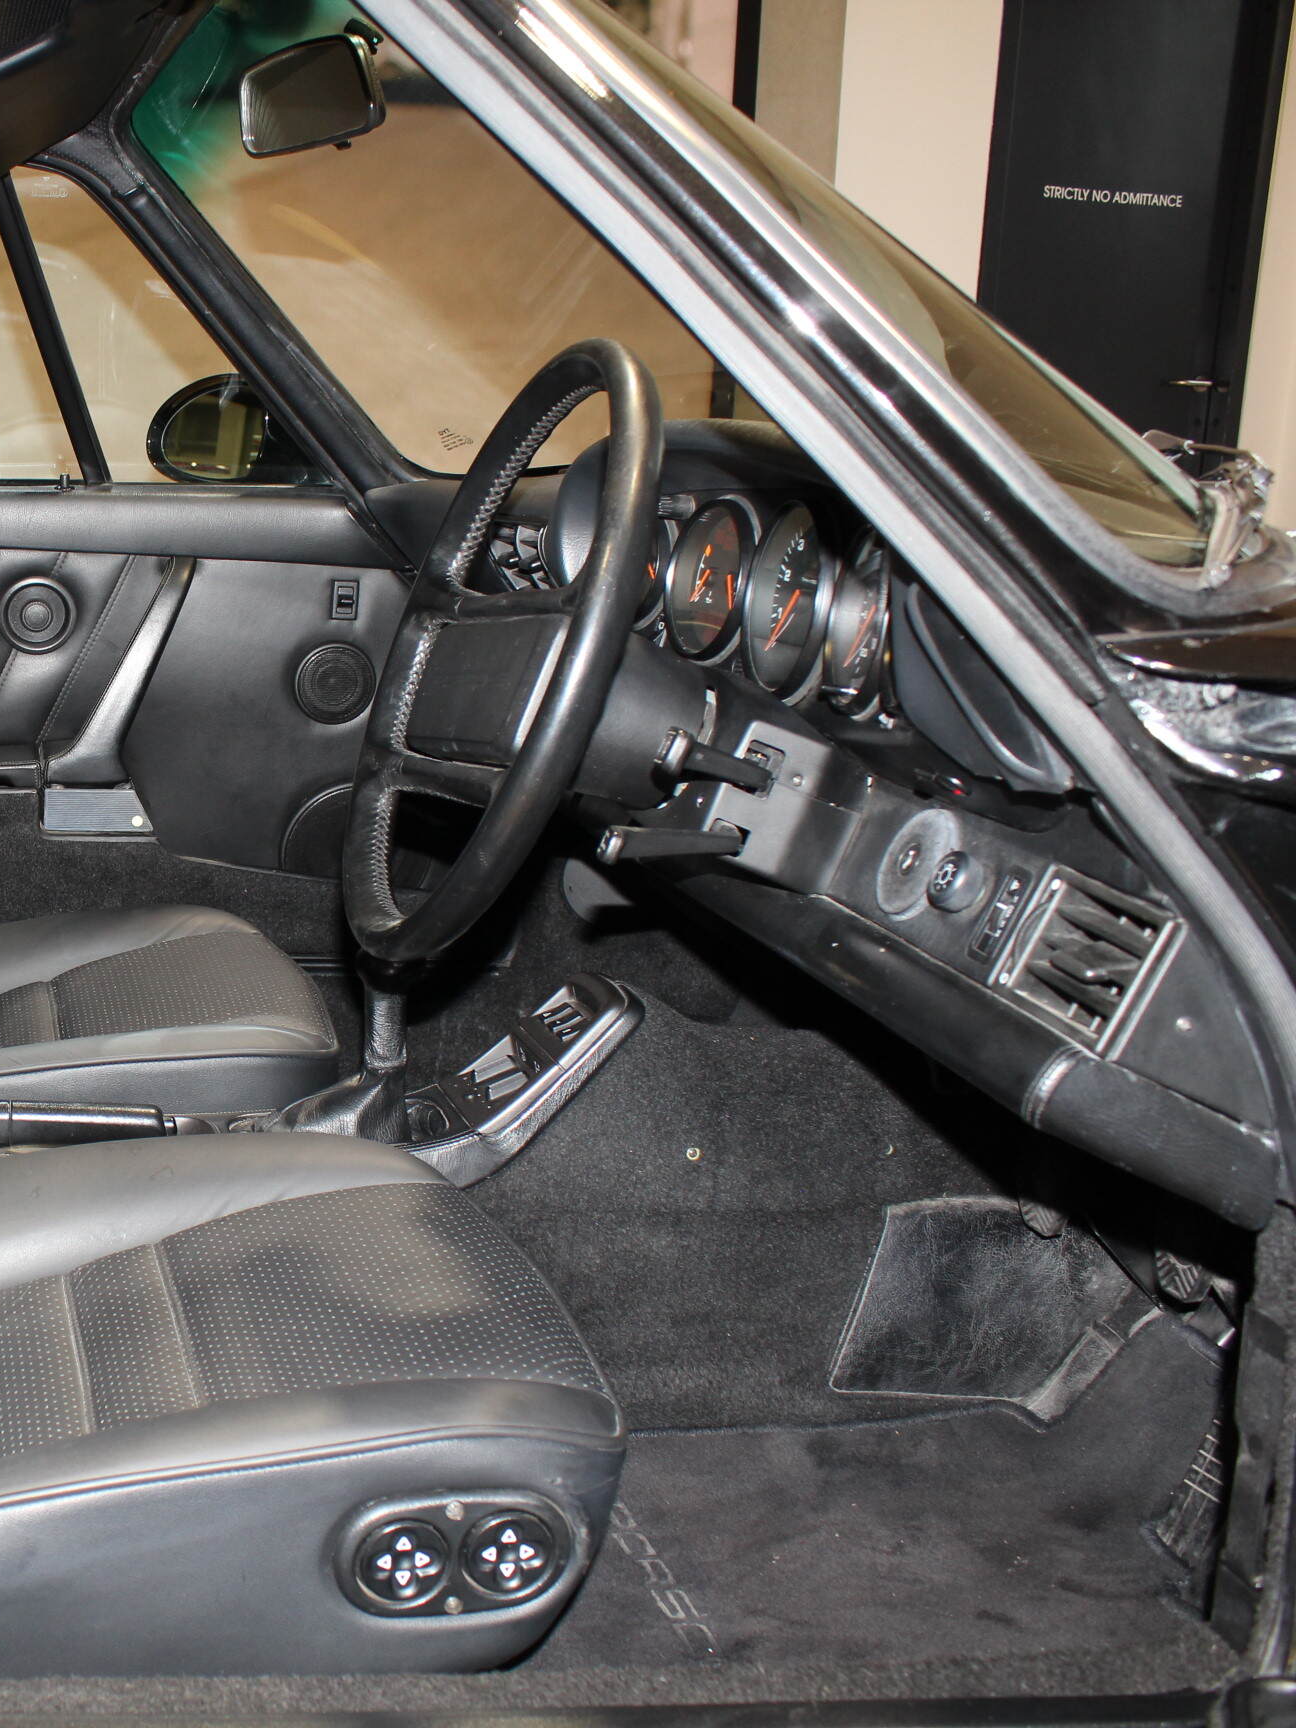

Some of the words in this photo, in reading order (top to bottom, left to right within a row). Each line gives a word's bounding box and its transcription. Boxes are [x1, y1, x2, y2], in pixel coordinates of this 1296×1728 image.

[1043, 185, 1089, 201] STRICTLY
[1092, 190, 1110, 203] NO
[1112, 192, 1183, 207] ADMITTANCE
